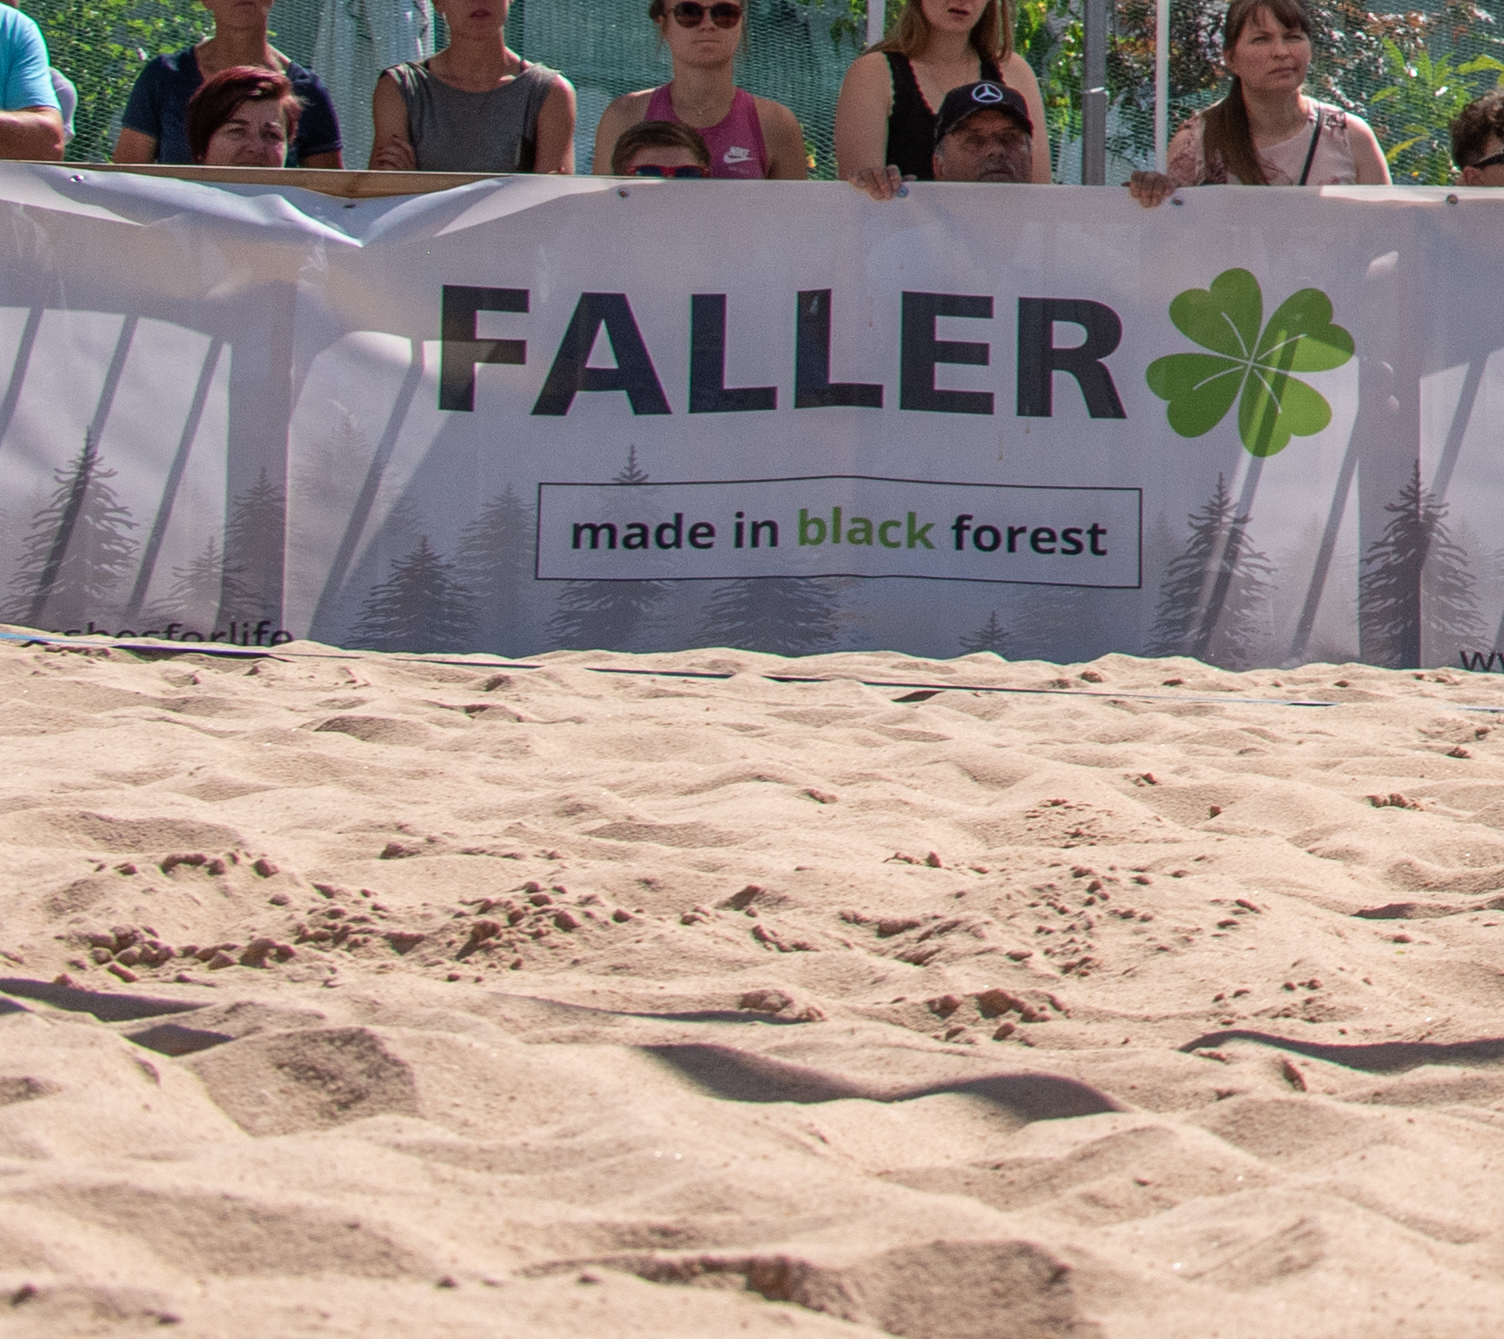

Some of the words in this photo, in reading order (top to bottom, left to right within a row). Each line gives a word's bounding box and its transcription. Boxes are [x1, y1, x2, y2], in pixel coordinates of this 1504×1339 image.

[437, 283, 1128, 420] FALLER
[570, 509, 716, 552] made
[733, 509, 780, 551] in
[796, 506, 936, 551] black
[950, 513, 1109, 559] forest
